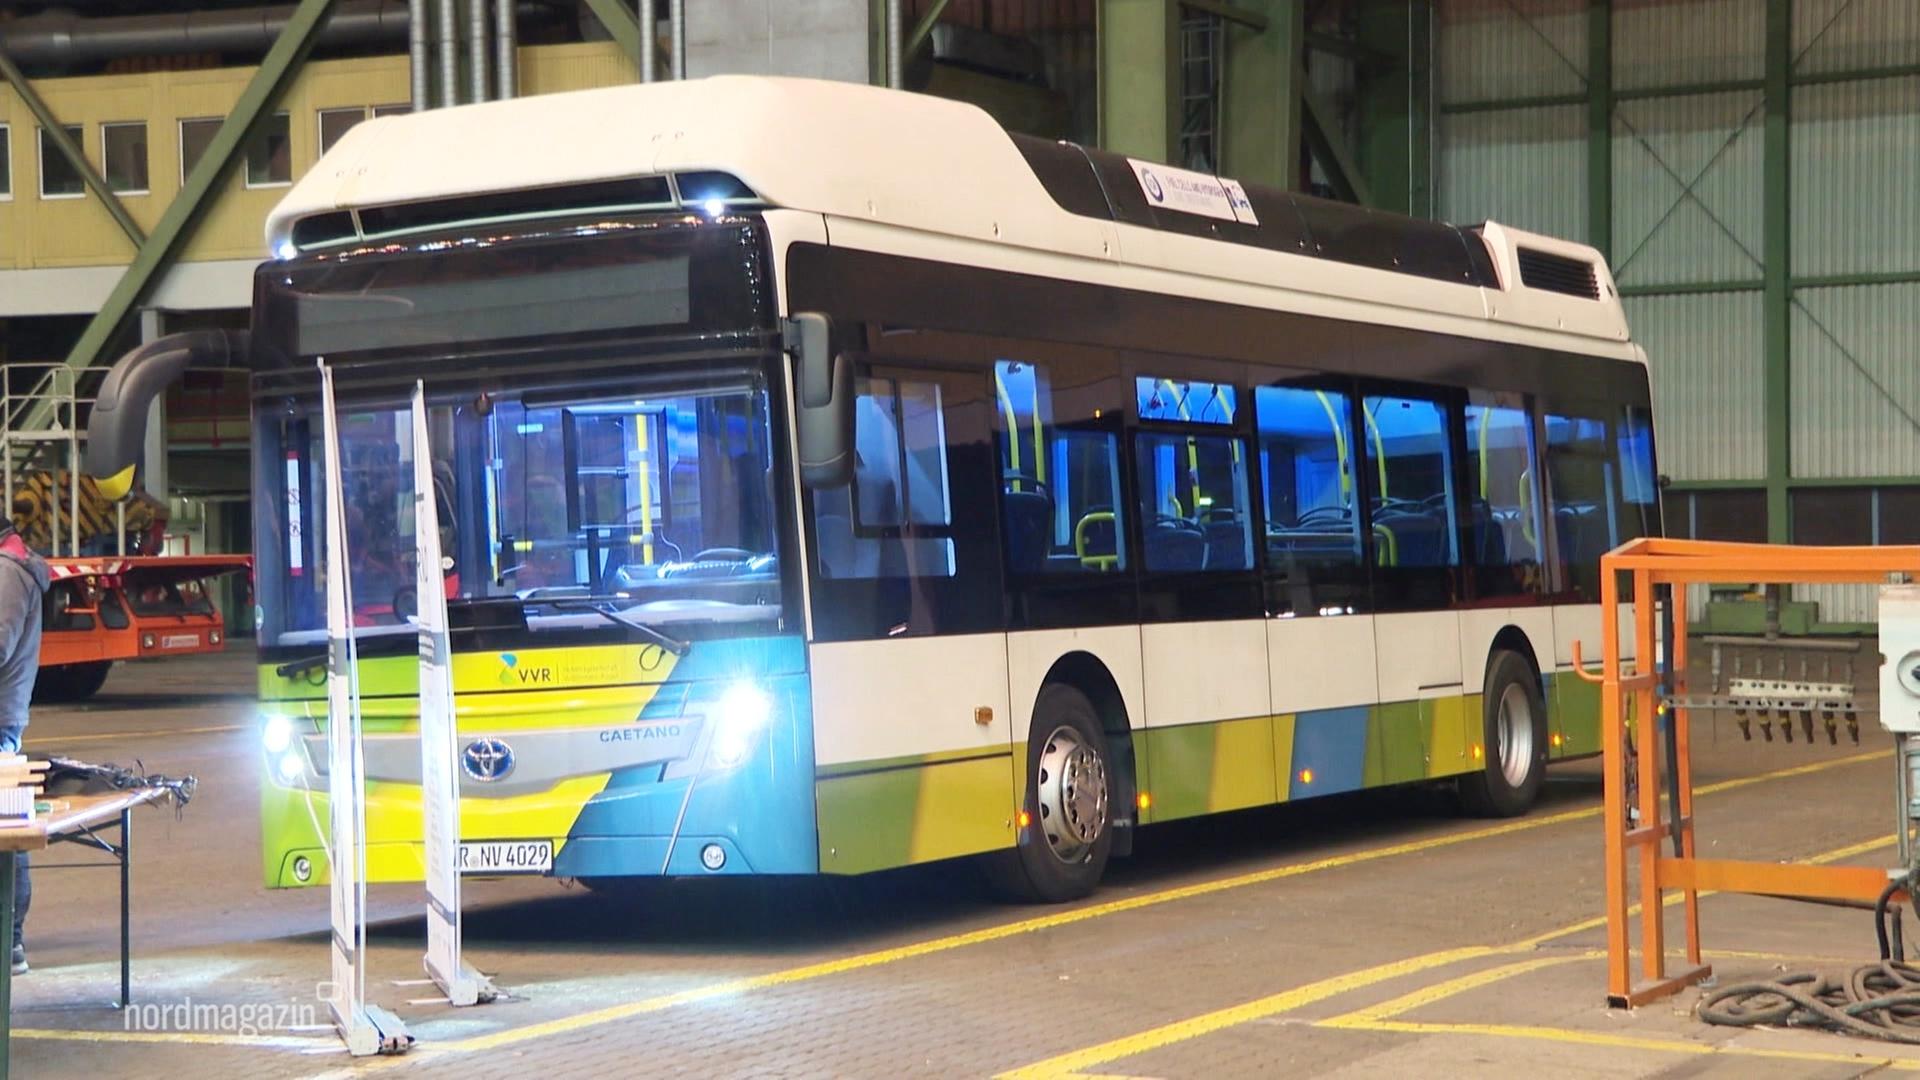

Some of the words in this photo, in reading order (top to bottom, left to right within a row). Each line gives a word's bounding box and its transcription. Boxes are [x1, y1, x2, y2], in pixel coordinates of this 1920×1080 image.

[518, 668, 551, 683] VVR
[599, 725, 681, 743] CAETANO
[455, 846, 469, 868] R
[480, 845, 501, 867] NV
[506, 844, 549, 866] 4029
